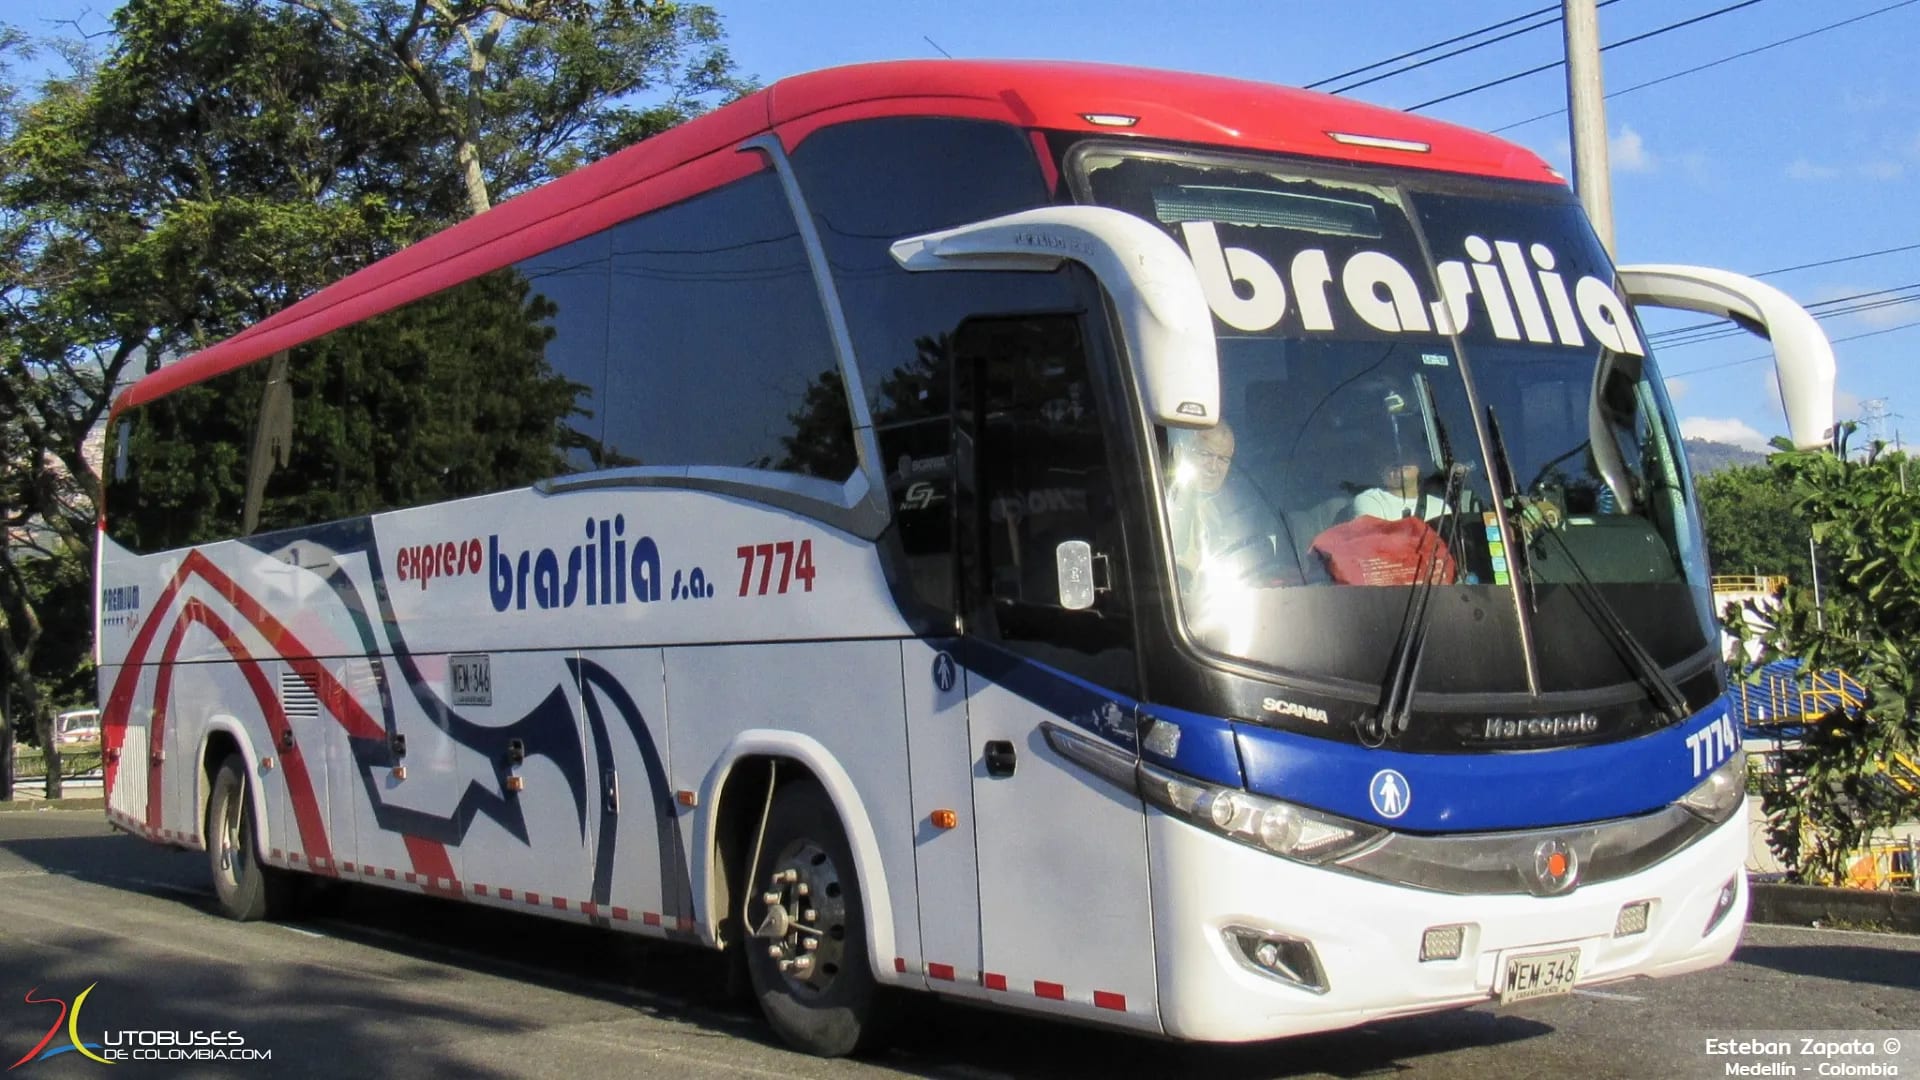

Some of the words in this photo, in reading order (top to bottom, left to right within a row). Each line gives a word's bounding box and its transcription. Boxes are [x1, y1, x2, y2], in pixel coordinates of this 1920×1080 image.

[1182, 221, 1645, 357] brasilia
[396, 538, 483, 591] expreso
[489, 513, 661, 613] brasilia
[671, 566, 714, 601] s.a.
[737, 539, 816, 597] 7774
[103, 585, 140, 612] PREMIUM
[1262, 697, 1329, 724] SCANIA
[1484, 712, 1599, 738] Marcopolo
[1685, 712, 1735, 778] 7774
